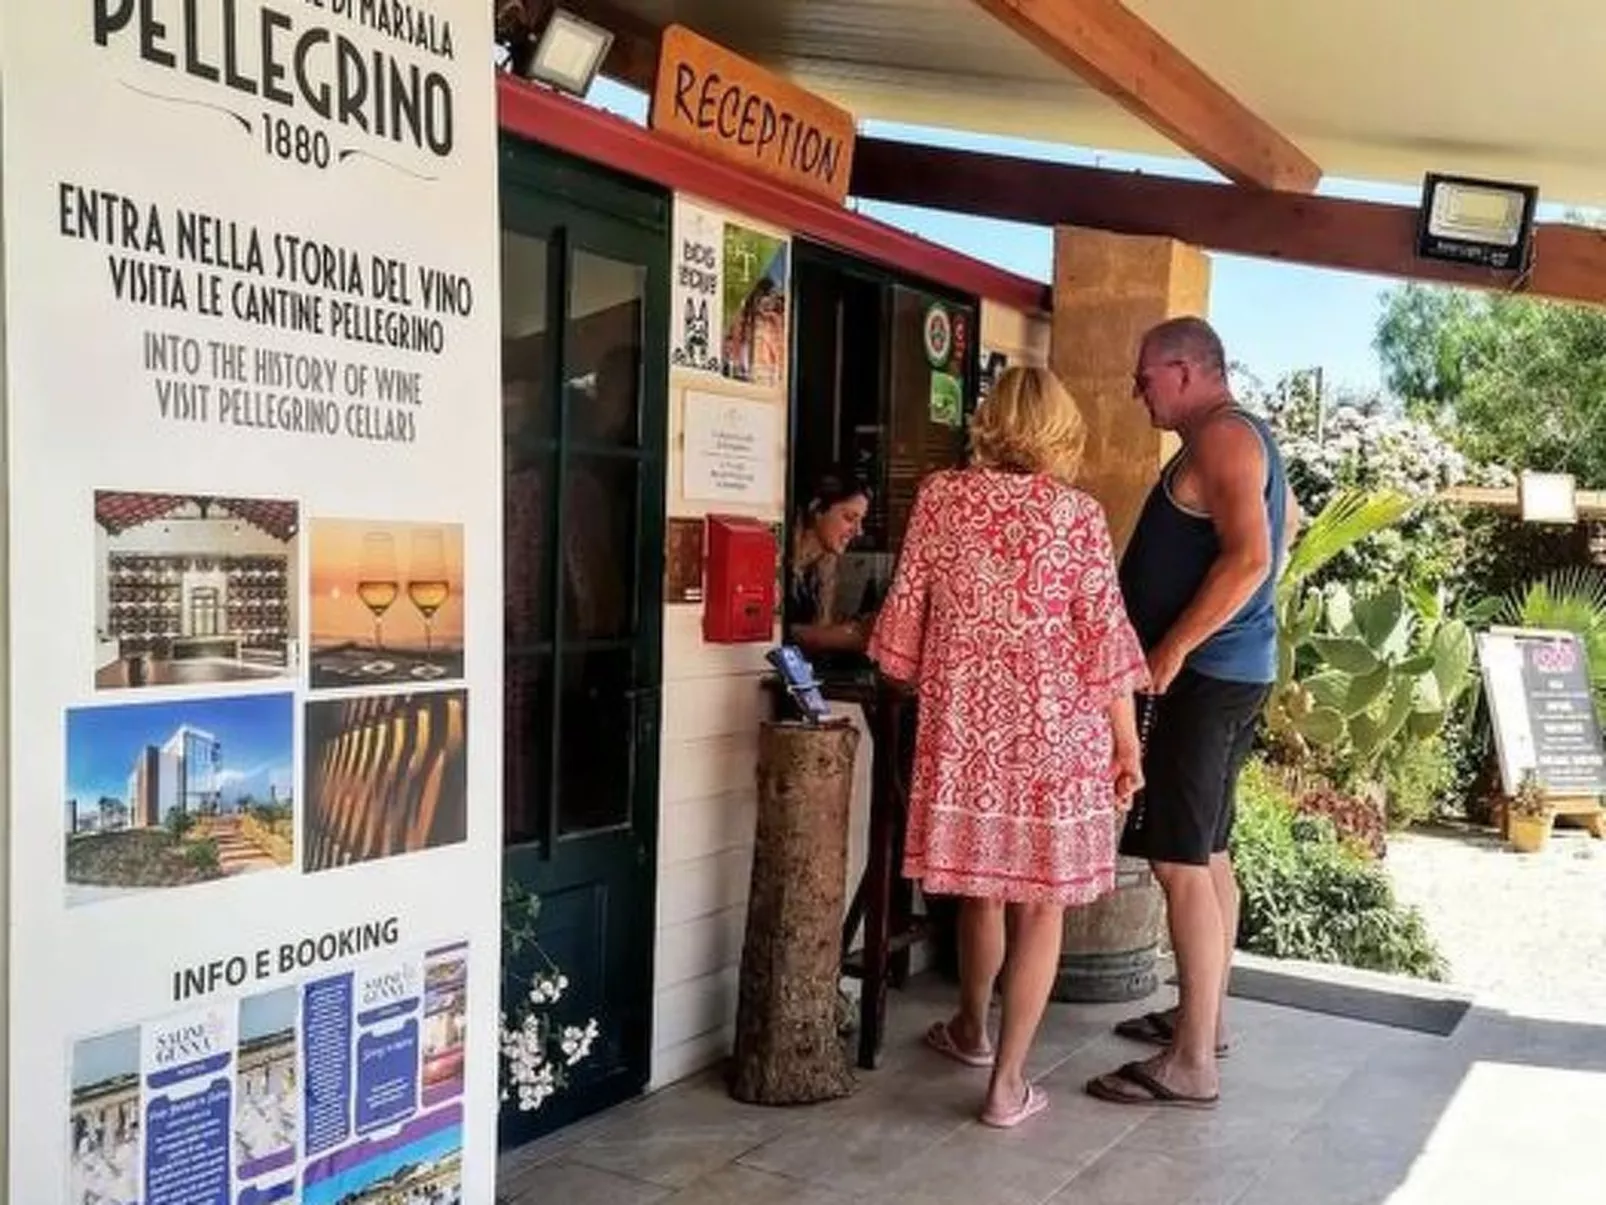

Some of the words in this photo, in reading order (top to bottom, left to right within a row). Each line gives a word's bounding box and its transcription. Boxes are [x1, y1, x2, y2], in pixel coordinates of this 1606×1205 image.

[262, 111, 330, 170] 1880
[674, 62, 844, 183] RECEPTION
[59, 182, 165, 255] ENTRA
[177, 208, 265, 275] NELLA
[273, 232, 365, 297] STORIA
[371, 254, 412, 306] DEL
[418, 265, 473, 317] VINO
[107, 254, 188, 311] VISITA
[197, 272, 224, 317] LE
[231, 280, 325, 336] CANTINE
[330, 301, 444, 356] PELLEGRINO
[143, 330, 201, 376] INTO
[208, 340, 248, 383] THE
[254, 347, 338, 394] HISTORY
[344, 363, 368, 398] OF
[374, 366, 422, 406] WINE
[155, 378, 211, 422] VISIT
[218, 387, 340, 436] PELLEGRINO
[345, 404, 416, 443] CELLARS
[173, 956, 248, 1001] INFO
[254, 949, 271, 980] E
[278, 916, 399, 974] BOOKING
